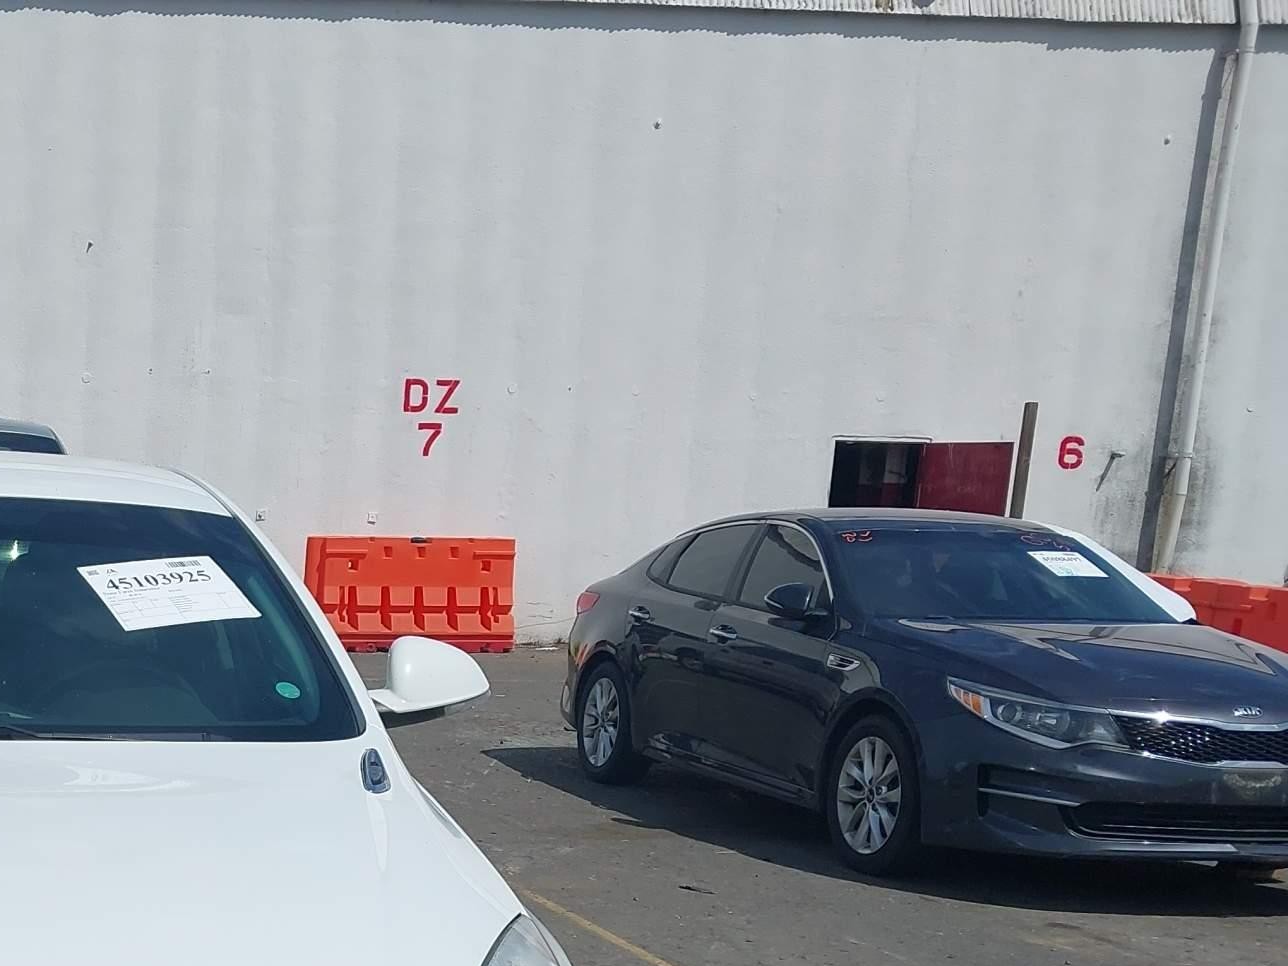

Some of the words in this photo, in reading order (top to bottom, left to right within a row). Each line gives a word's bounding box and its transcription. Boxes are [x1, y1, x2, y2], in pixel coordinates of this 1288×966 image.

[403, 378, 460, 414] DZ
[418, 422, 442, 456] 7
[1058, 436, 1085, 469] 6
[106, 570, 212, 591] 45103925
